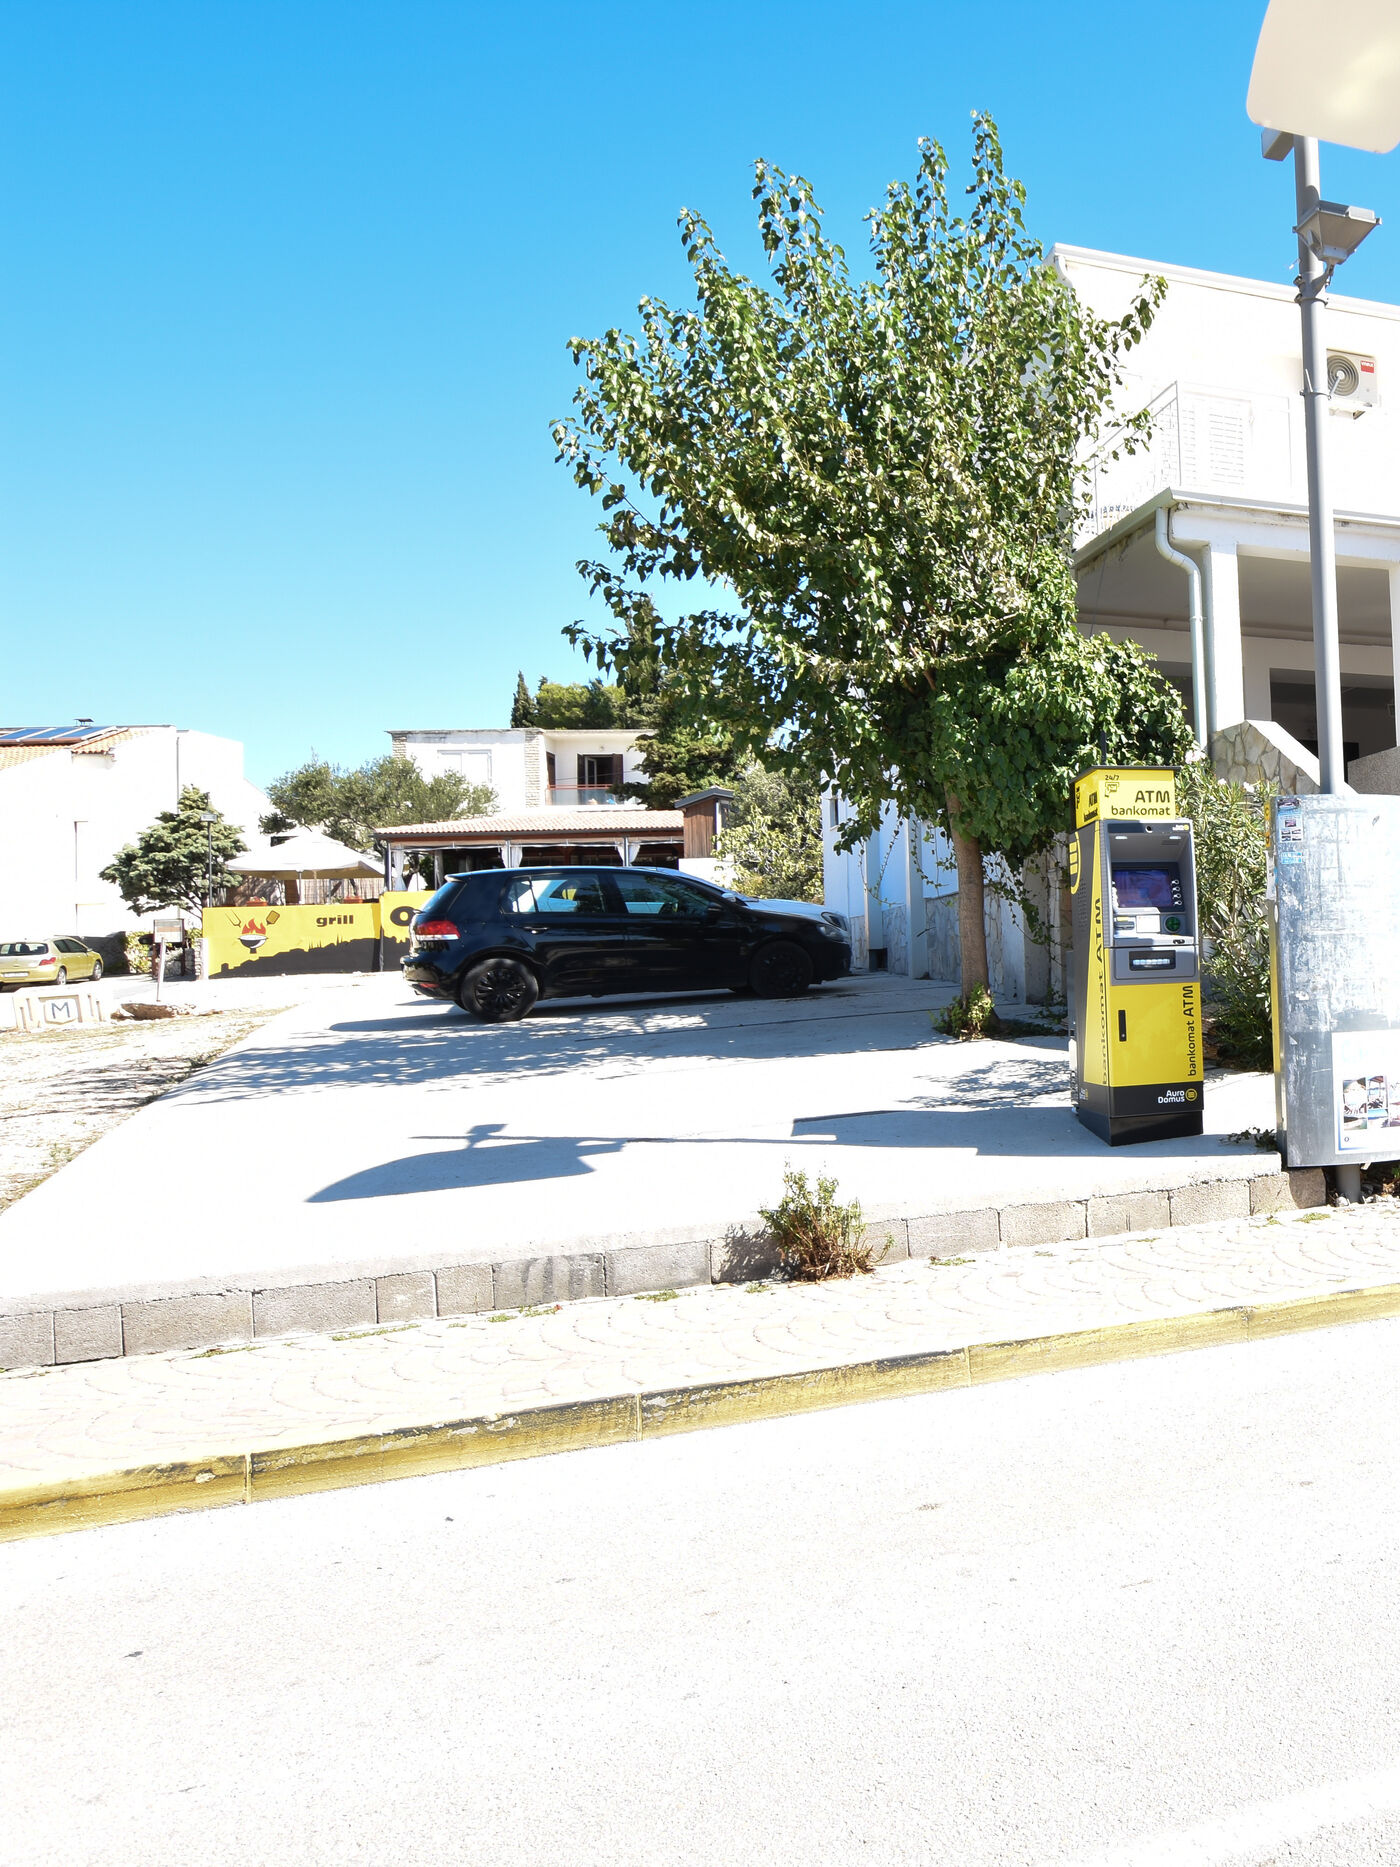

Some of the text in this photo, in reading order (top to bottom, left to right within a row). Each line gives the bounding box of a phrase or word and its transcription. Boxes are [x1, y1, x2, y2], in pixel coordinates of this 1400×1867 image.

[1135, 790, 1170, 803] ATM
[1111, 806, 1171, 816] bankomat
[316, 914, 354, 927] grill
[1095, 897, 1103, 963] ATM
[1182, 985, 1197, 1076] bankomat ATM
[1157, 1095, 1185, 1104] Domus
[1166, 1089, 1185, 1097] Auro
